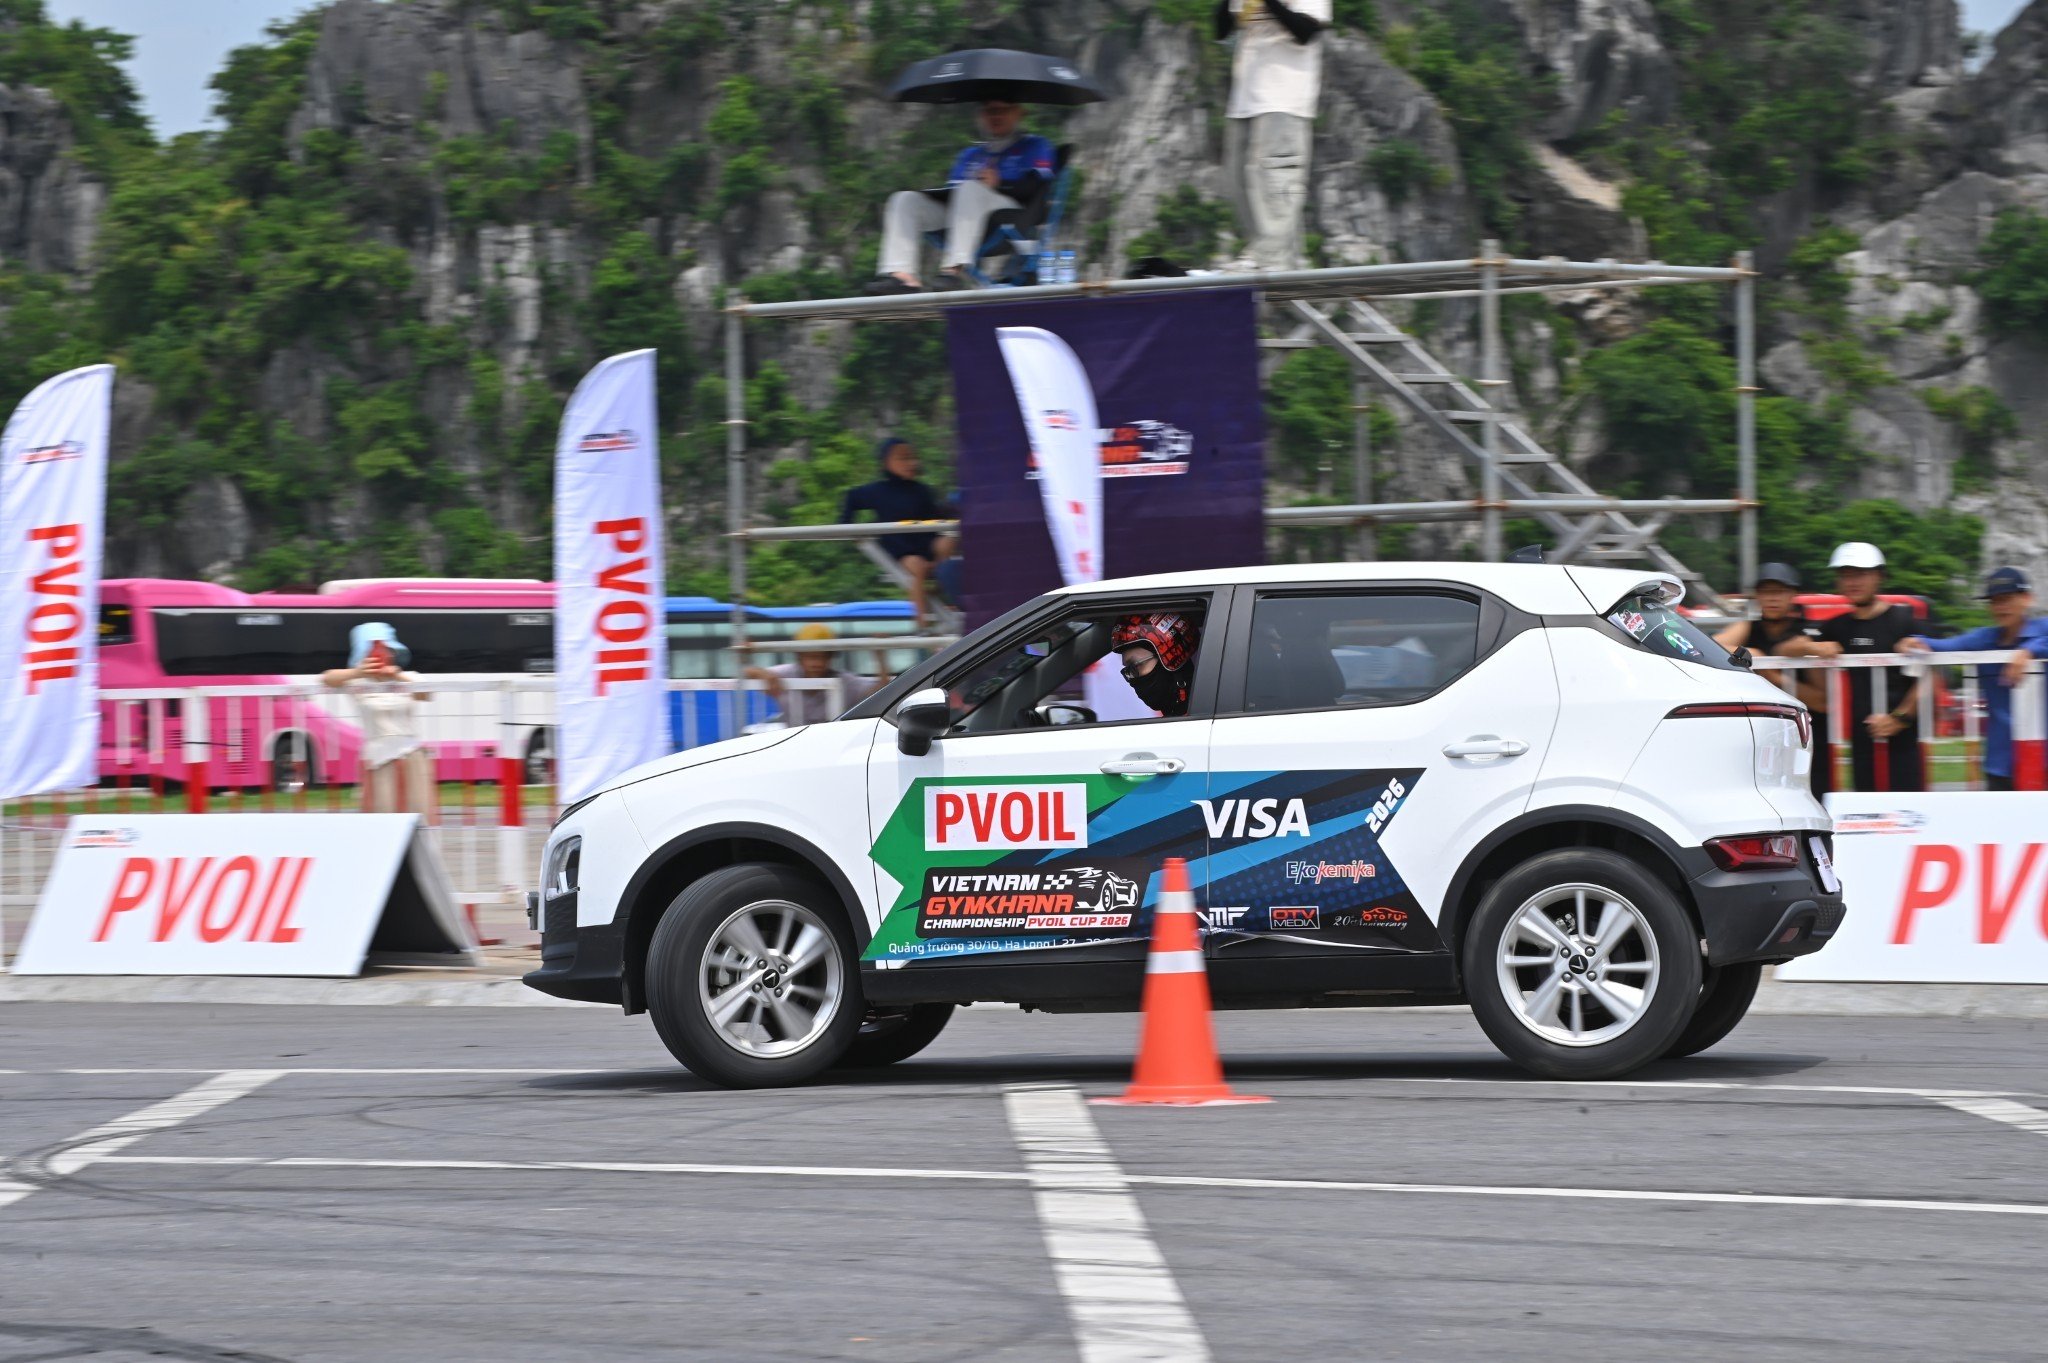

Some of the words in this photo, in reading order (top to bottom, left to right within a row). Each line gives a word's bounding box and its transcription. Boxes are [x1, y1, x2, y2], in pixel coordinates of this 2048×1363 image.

[26, 524, 85, 695] PVOIL
[592, 517, 652, 696] PVOIL
[935, 791, 1076, 843] PVOIL
[1190, 798, 1311, 839] VISA
[1364, 777, 1406, 834] 2026
[931, 874, 1040, 892] VIETNAM
[1286, 860, 1376, 885] Ekokemika
[90, 855, 314, 943] PVOIL
[926, 894, 1074, 916] GYMKHANA
[1887, 843, 2048, 944] PV
[923, 917, 1025, 930] CHAMPIONSHIP
[1027, 916, 1066, 927] PVOIL
[1069, 916, 1098, 926] CUP
[1100, 915, 1129, 926] 2026
[1272, 909, 1316, 920] OTV
[1272, 919, 1317, 928] MEDIA
[888, 941, 925, 955] Quảng
